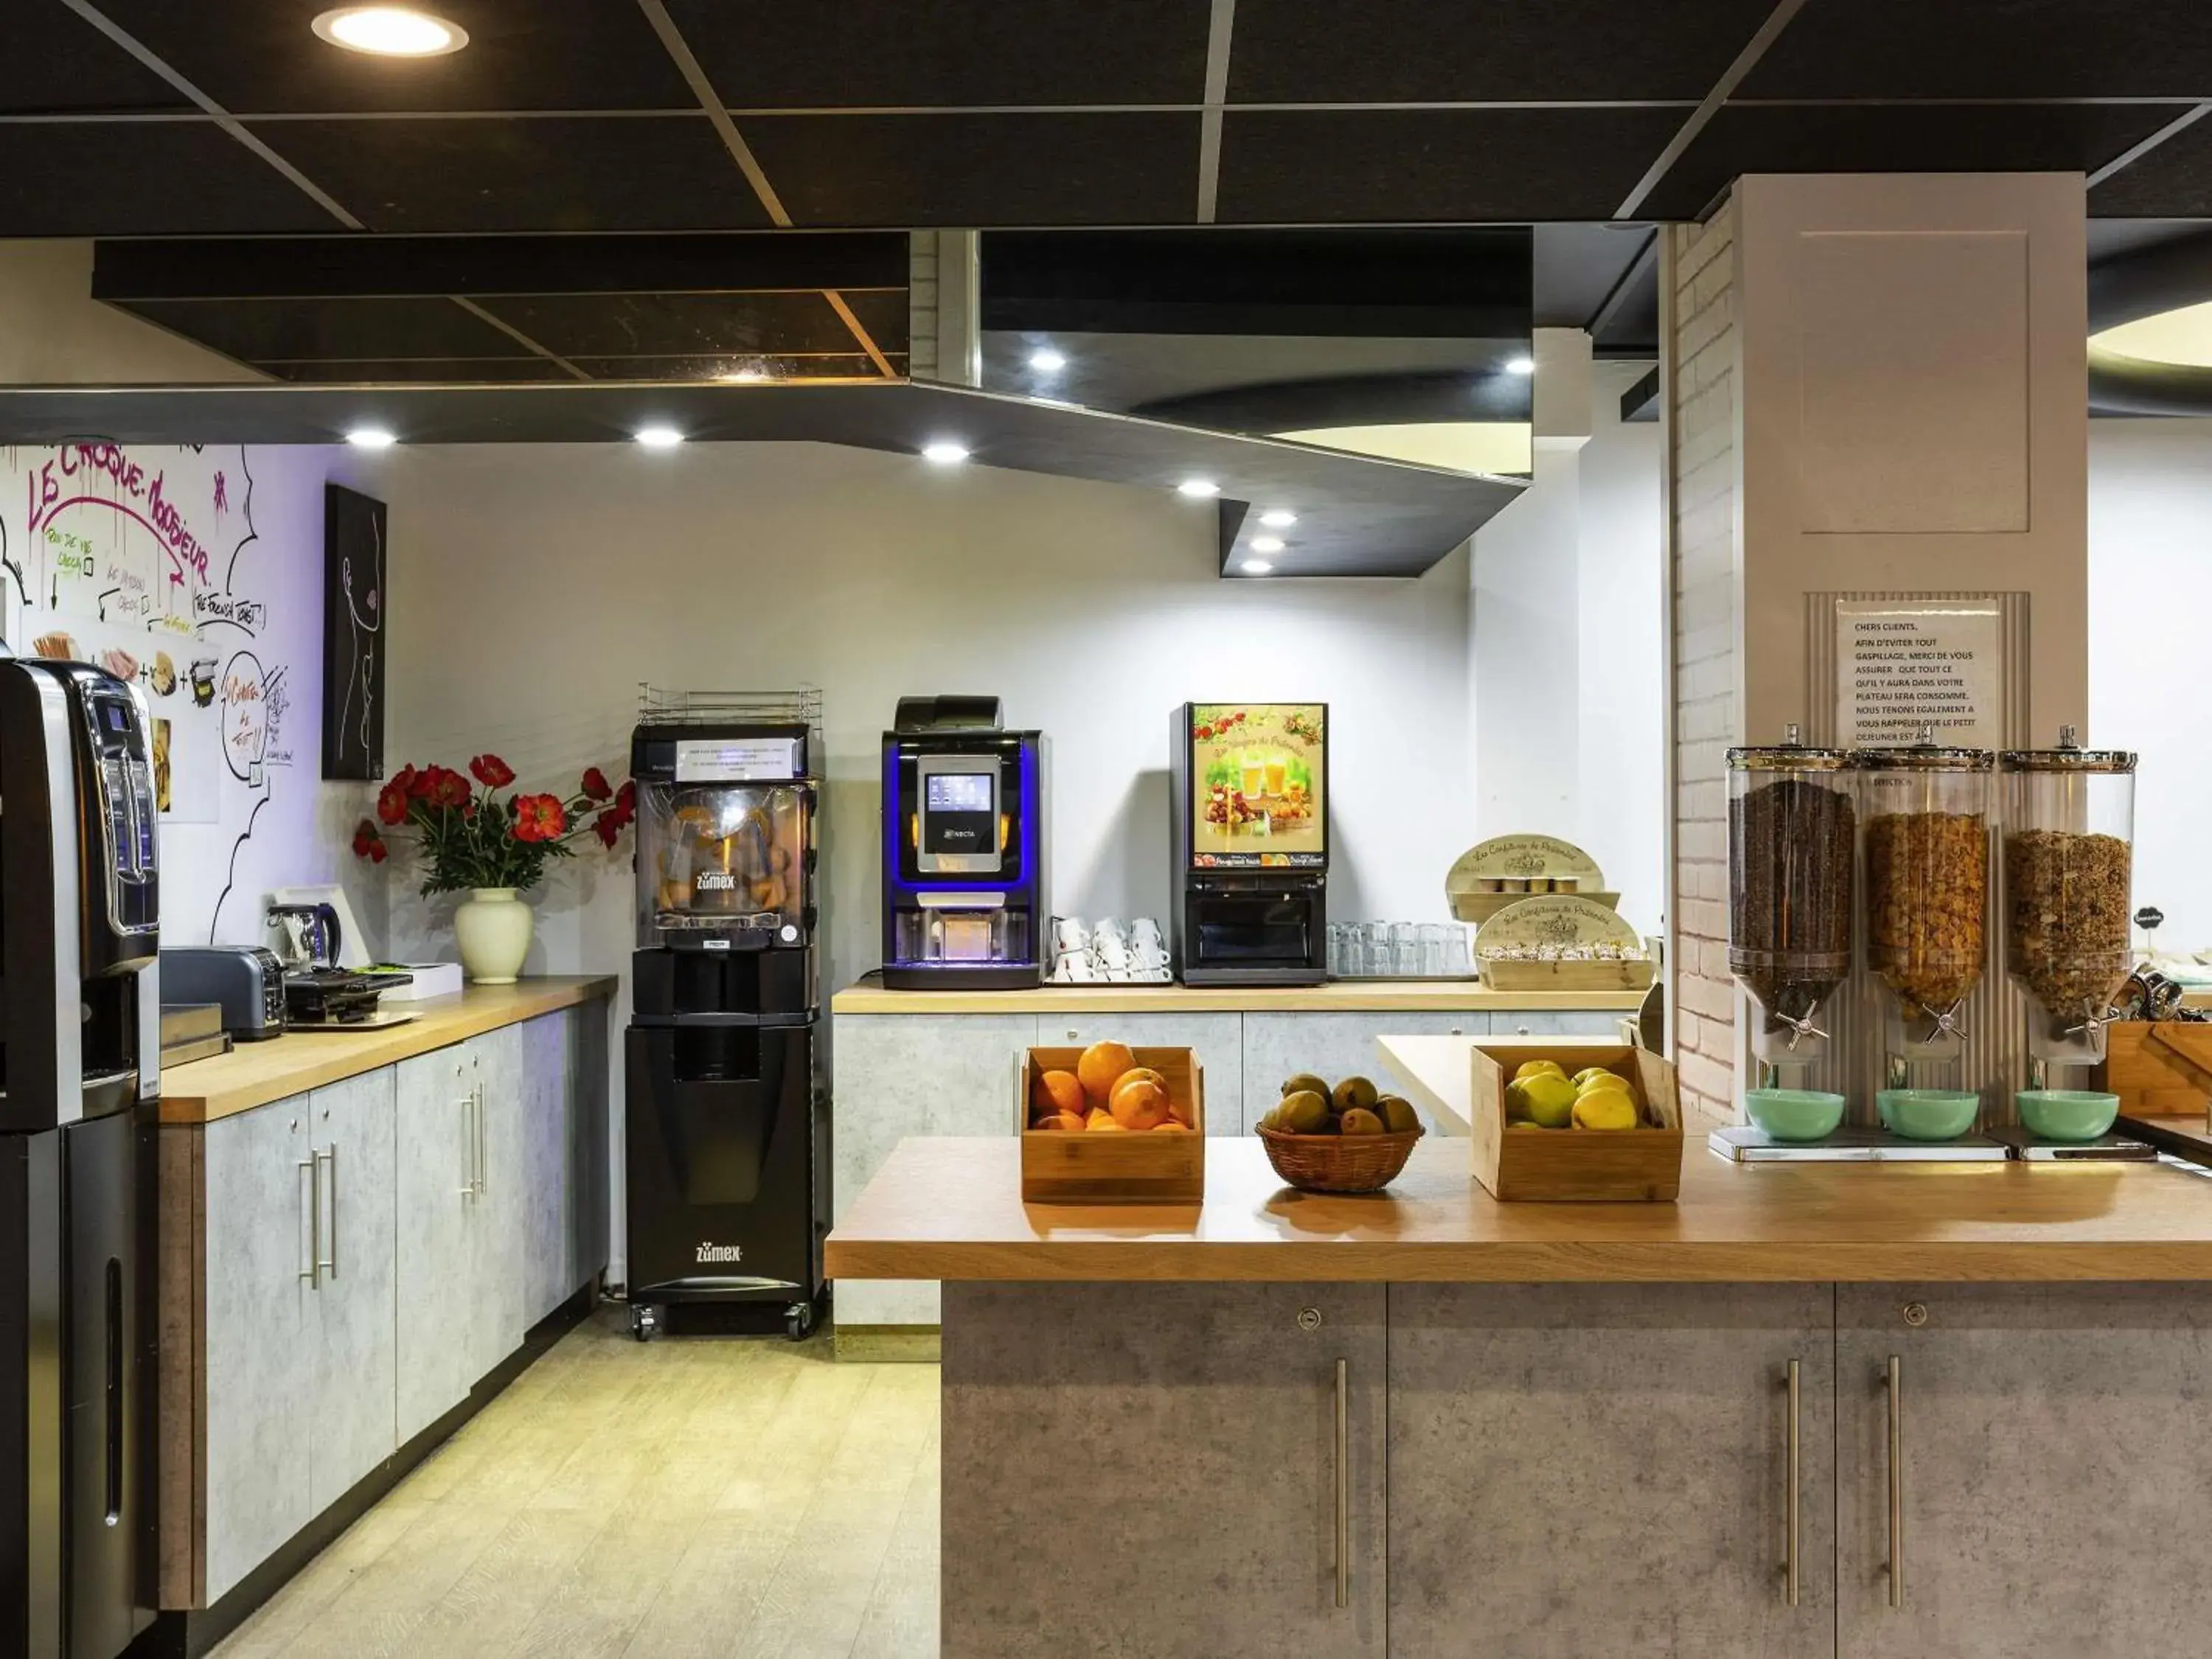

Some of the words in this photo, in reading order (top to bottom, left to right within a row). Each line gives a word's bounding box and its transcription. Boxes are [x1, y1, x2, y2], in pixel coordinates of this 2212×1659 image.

[1909, 652, 1935, 660] MERCI
[1950, 652, 1973, 660] VOUS
[1855, 666, 1893, 674] ASSURER
[1856, 692, 1893, 700] PLATEAU
[1894, 692, 1915, 700] SERA
[1856, 706, 1879, 714] NOUS
[1882, 706, 1915, 714] TENONS
[1856, 720, 1879, 728] VOUS
[1881, 719, 1921, 728] RAPPELER
[1856, 733, 1897, 741] DEJEUNER
[1899, 732, 1913, 741] EST
